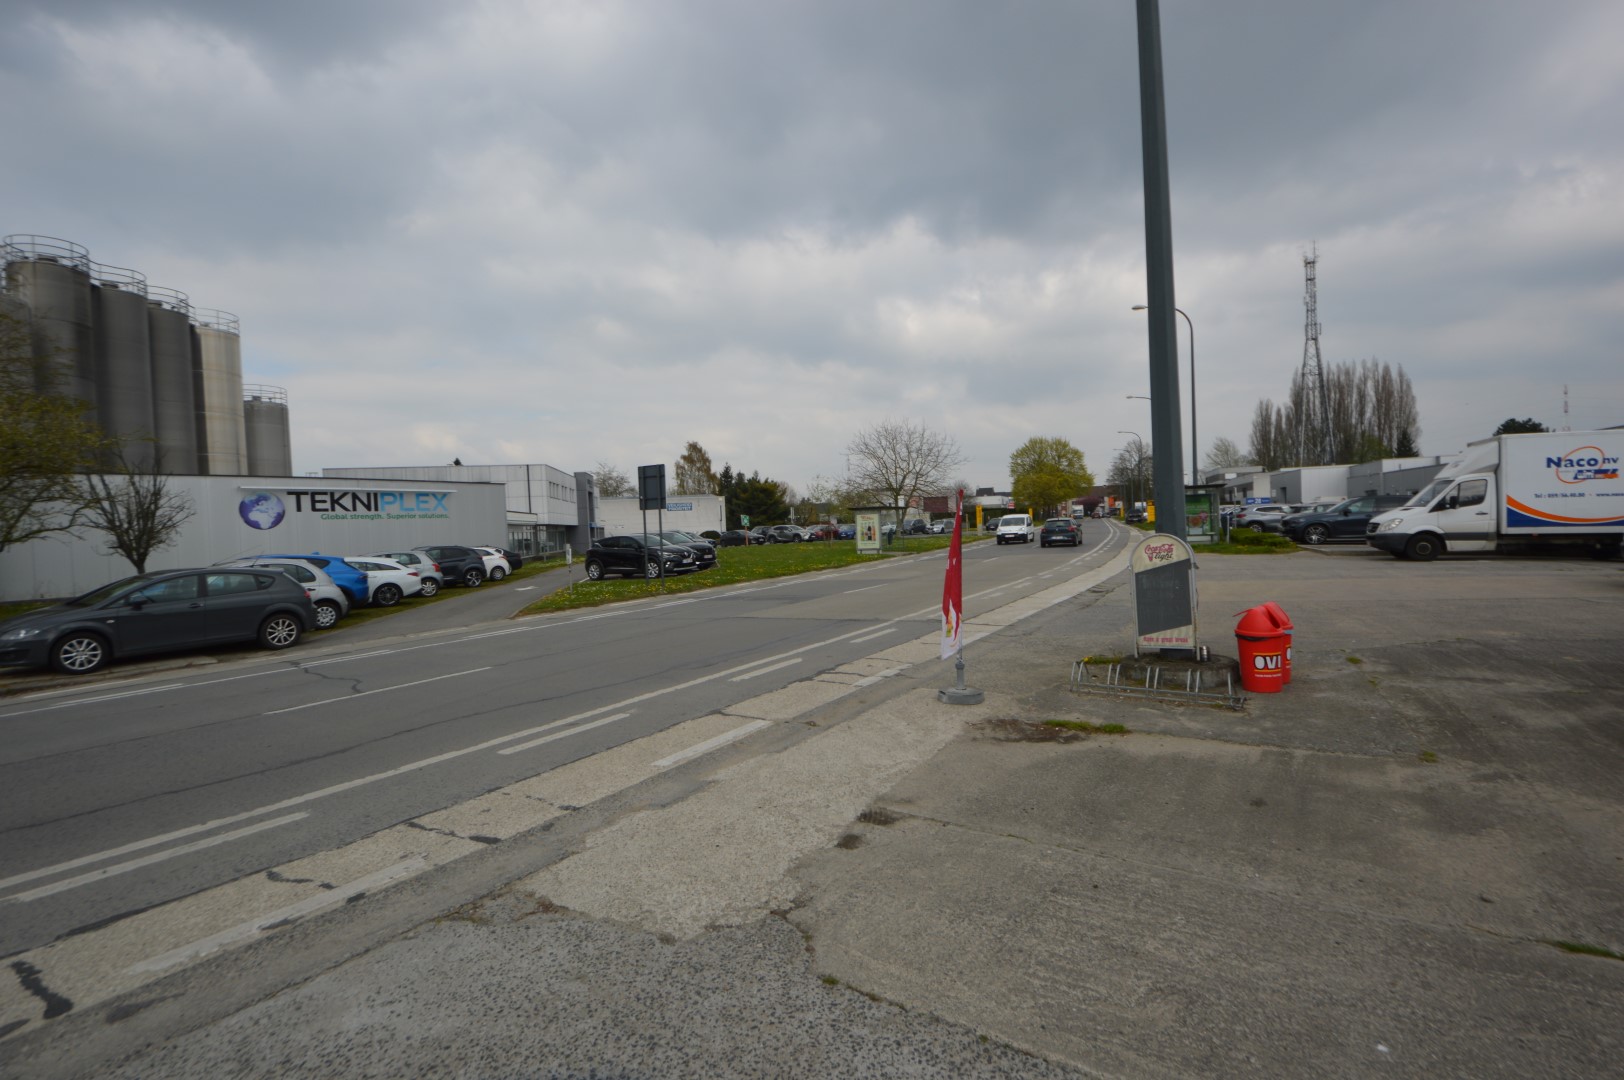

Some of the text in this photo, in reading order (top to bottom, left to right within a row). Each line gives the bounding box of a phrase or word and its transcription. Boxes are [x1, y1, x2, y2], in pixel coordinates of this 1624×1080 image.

[1546, 456, 1599, 468] Naco
[286, 491, 449, 513] TEKNIPLEX
[350, 513, 384, 521] strength.
